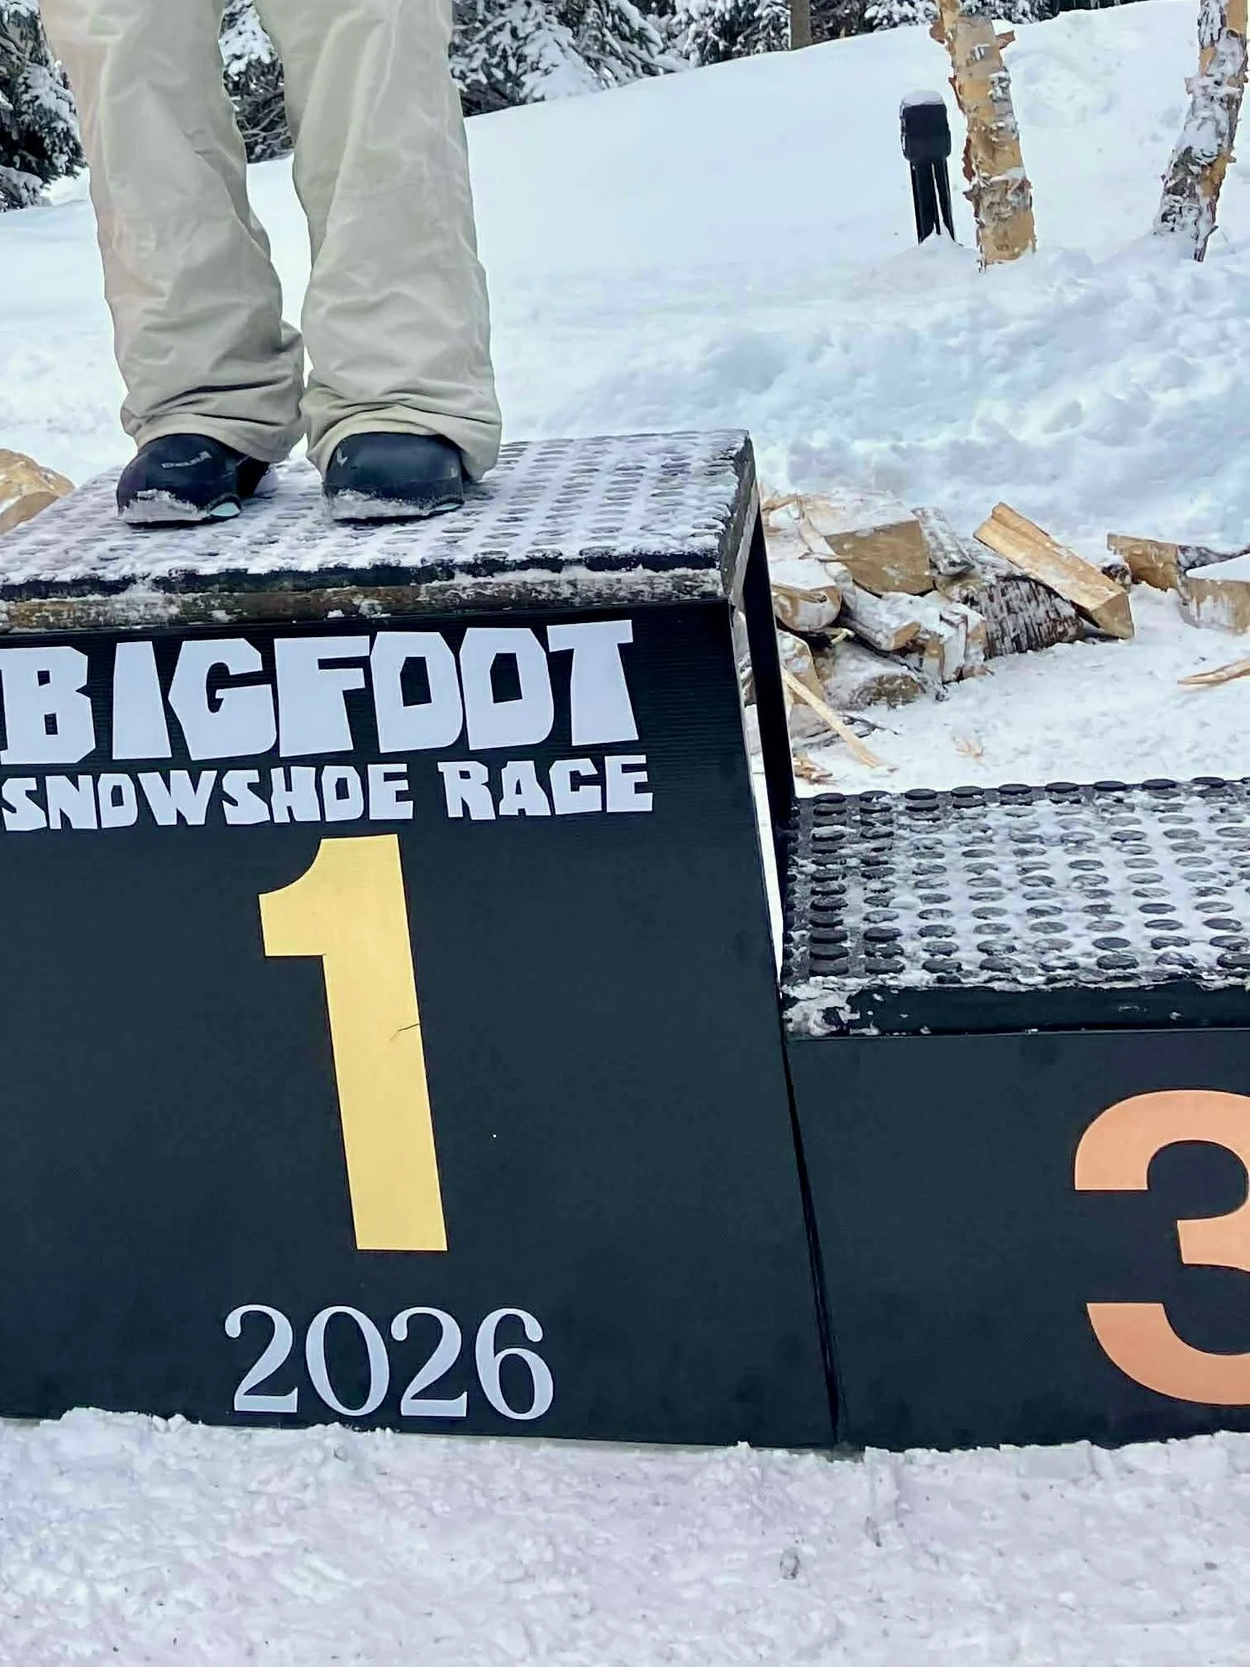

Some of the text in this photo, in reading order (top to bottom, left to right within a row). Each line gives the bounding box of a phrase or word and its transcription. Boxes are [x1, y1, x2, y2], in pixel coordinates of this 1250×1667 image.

[0, 754, 654, 832] SNOWSHOE RACE
[258, 833, 448, 1251] 1
[1073, 1089, 1250, 1406] 3
[223, 1304, 554, 1421] 2026
